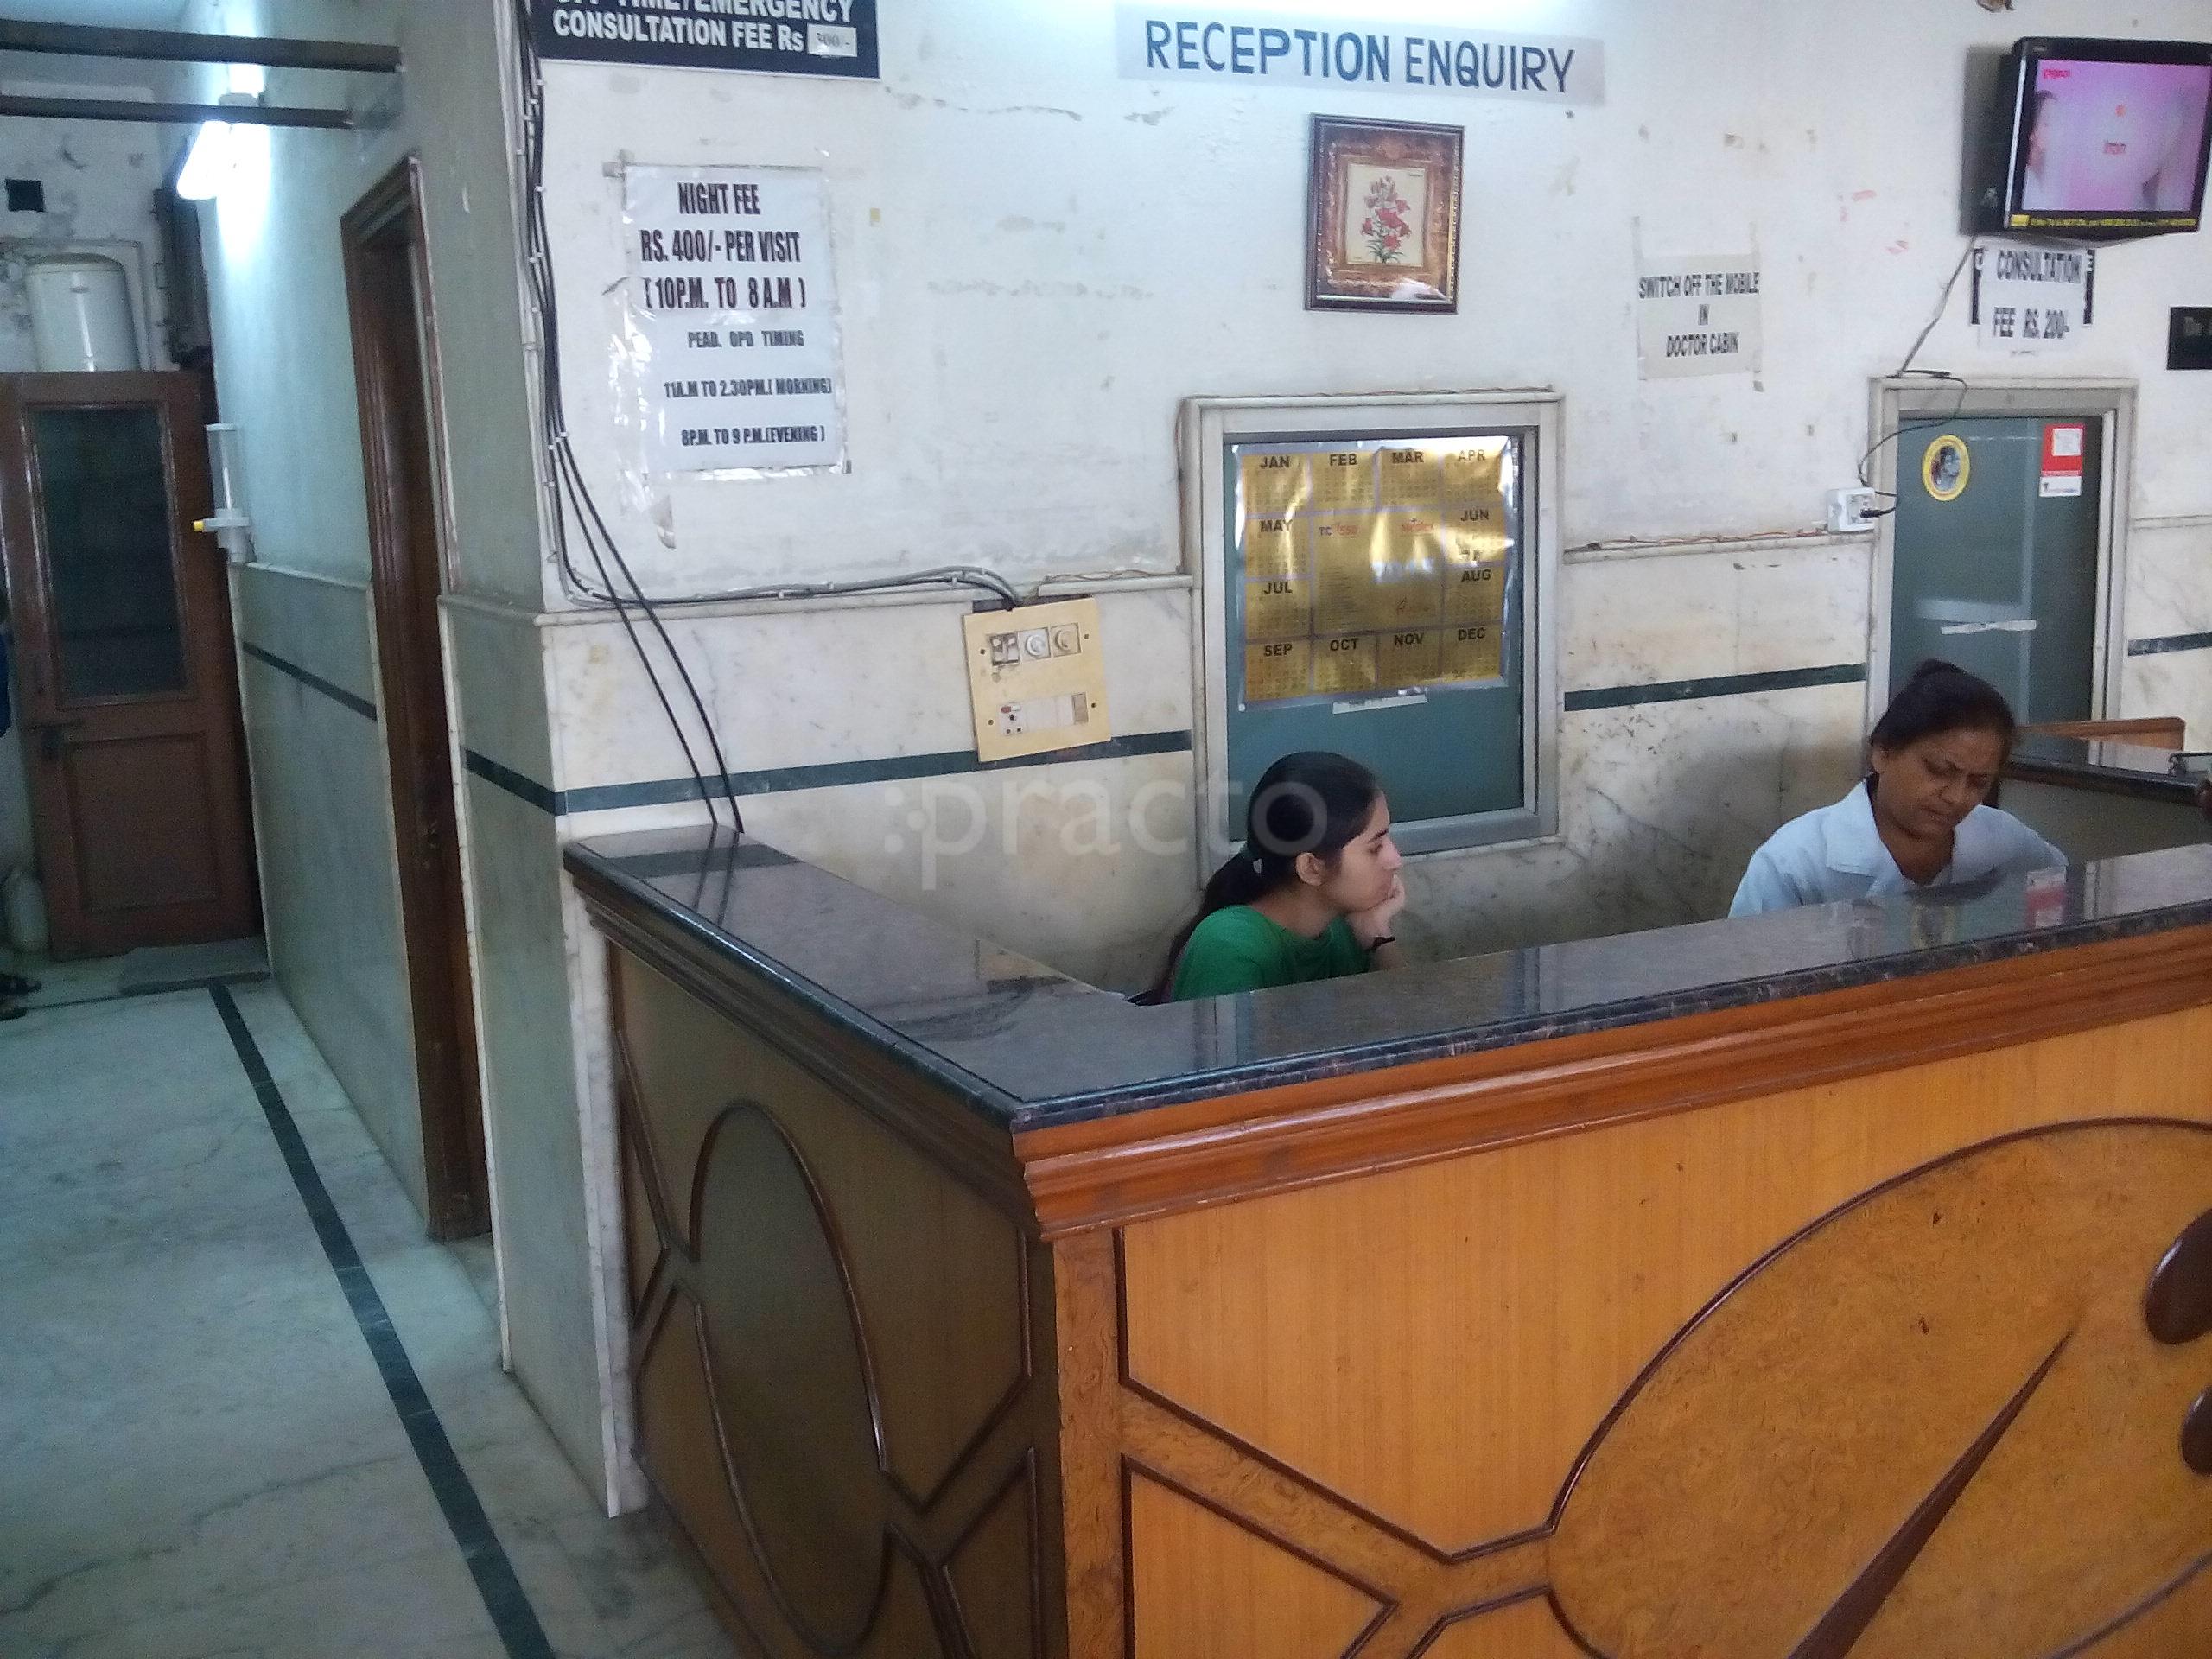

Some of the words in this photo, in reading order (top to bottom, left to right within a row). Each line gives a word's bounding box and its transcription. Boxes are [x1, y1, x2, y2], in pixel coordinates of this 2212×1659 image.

[553, 9, 727, 47] CONSULTATION
[732, 20, 772, 50] FEE
[778, 24, 804, 53] Rs
[1146, 19, 1389, 83] RECEPTION
[1405, 37, 1575, 93] ENQUIRY
[677, 182, 728, 214] NIGHT
[733, 183, 761, 215] FEE
[639, 230, 669, 262] RS.
[725, 231, 755, 262] PER
[758, 232, 801, 262] VISIT
[1997, 250, 2082, 283] CONSULTATION
[714, 277, 737, 308] TO
[1638, 275, 1681, 299] SWITCH
[1684, 274, 1702, 296] OFF
[1705, 273, 1723, 296] THE
[1726, 272, 1759, 295] MOBILE
[1993, 307, 2016, 338] FEE
[729, 331, 754, 347] OPD
[761, 329, 804, 346] TIMING
[1666, 334, 1707, 358] DOCTOR
[1710, 332, 1739, 355] CABIN
[701, 380, 717, 397] TO
[714, 429, 730, 444] TO
[1260, 455, 1291, 468] JAN
[1329, 454, 1358, 467] FEB
[1392, 451, 1424, 464] MAR
[1458, 449, 1485, 462] APR
[1260, 518, 1293, 533] MAY
[1460, 510, 1490, 522] JUN
[1263, 582, 1293, 594] JUL
[1461, 569, 1491, 582] AUG
[1263, 644, 1293, 657] SEP
[1330, 639, 1358, 652] OCT
[1394, 633, 1424, 646] NOV
[1458, 627, 1486, 641] DEC
